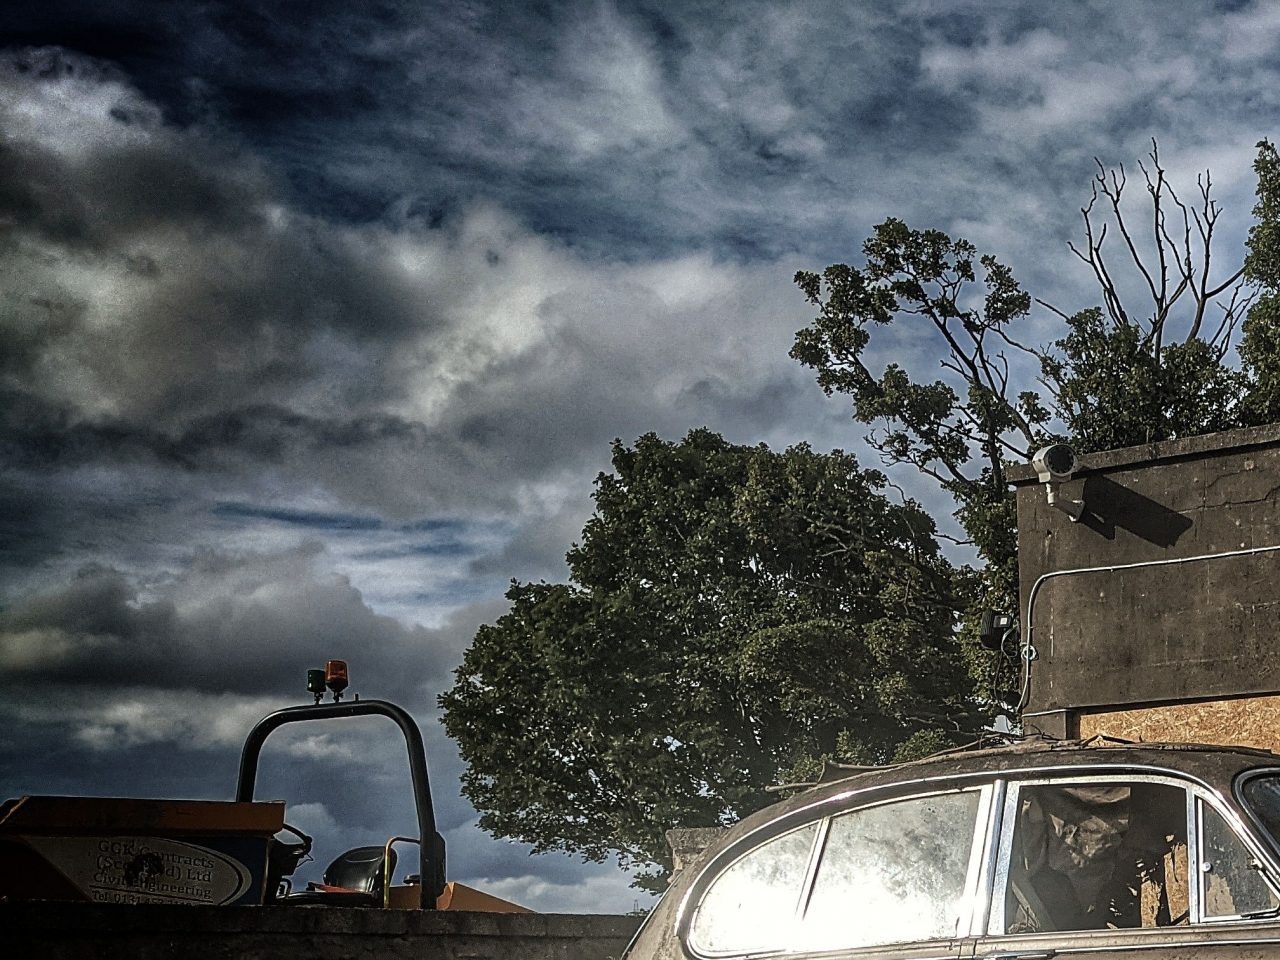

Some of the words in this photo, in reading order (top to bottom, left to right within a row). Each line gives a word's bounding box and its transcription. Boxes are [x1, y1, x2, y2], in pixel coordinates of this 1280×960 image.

[140, 846, 214, 868] Cntracts
[94, 872, 126, 885] Civil
[188, 869, 211, 882] Ltd
